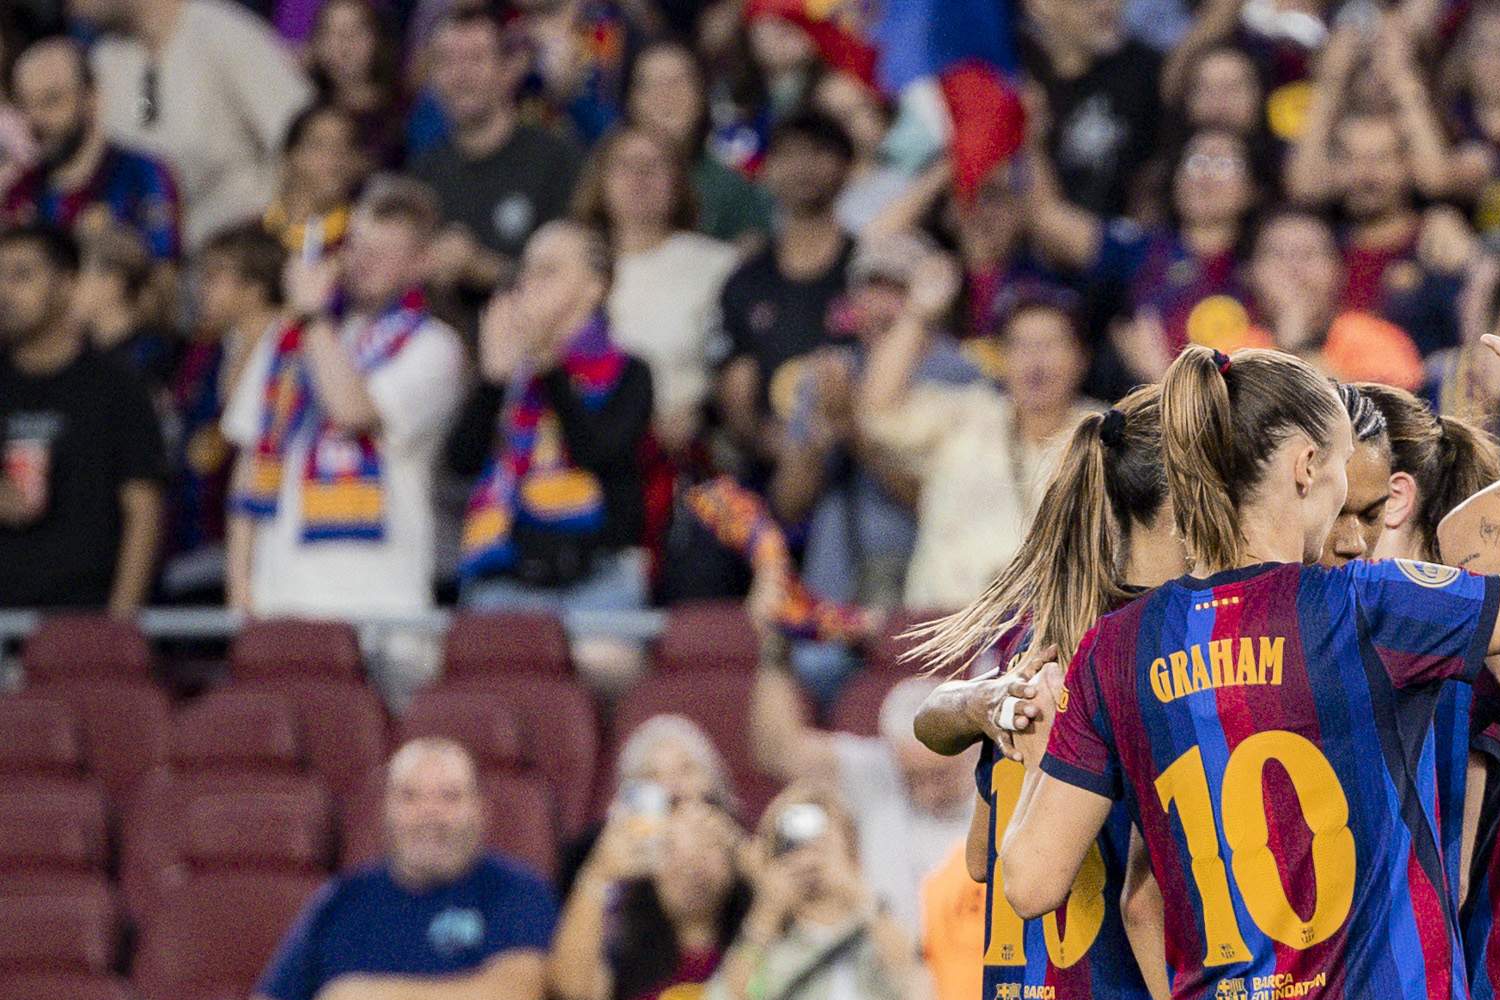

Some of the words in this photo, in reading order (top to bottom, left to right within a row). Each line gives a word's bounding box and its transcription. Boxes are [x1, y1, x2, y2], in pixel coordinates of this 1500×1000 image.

[1150, 636, 1285, 703] GRAHAM
[1154, 730, 1356, 967] 10
[1023, 985, 1055, 1000] BARÇA
[1252, 973, 1294, 991] BARÇA
